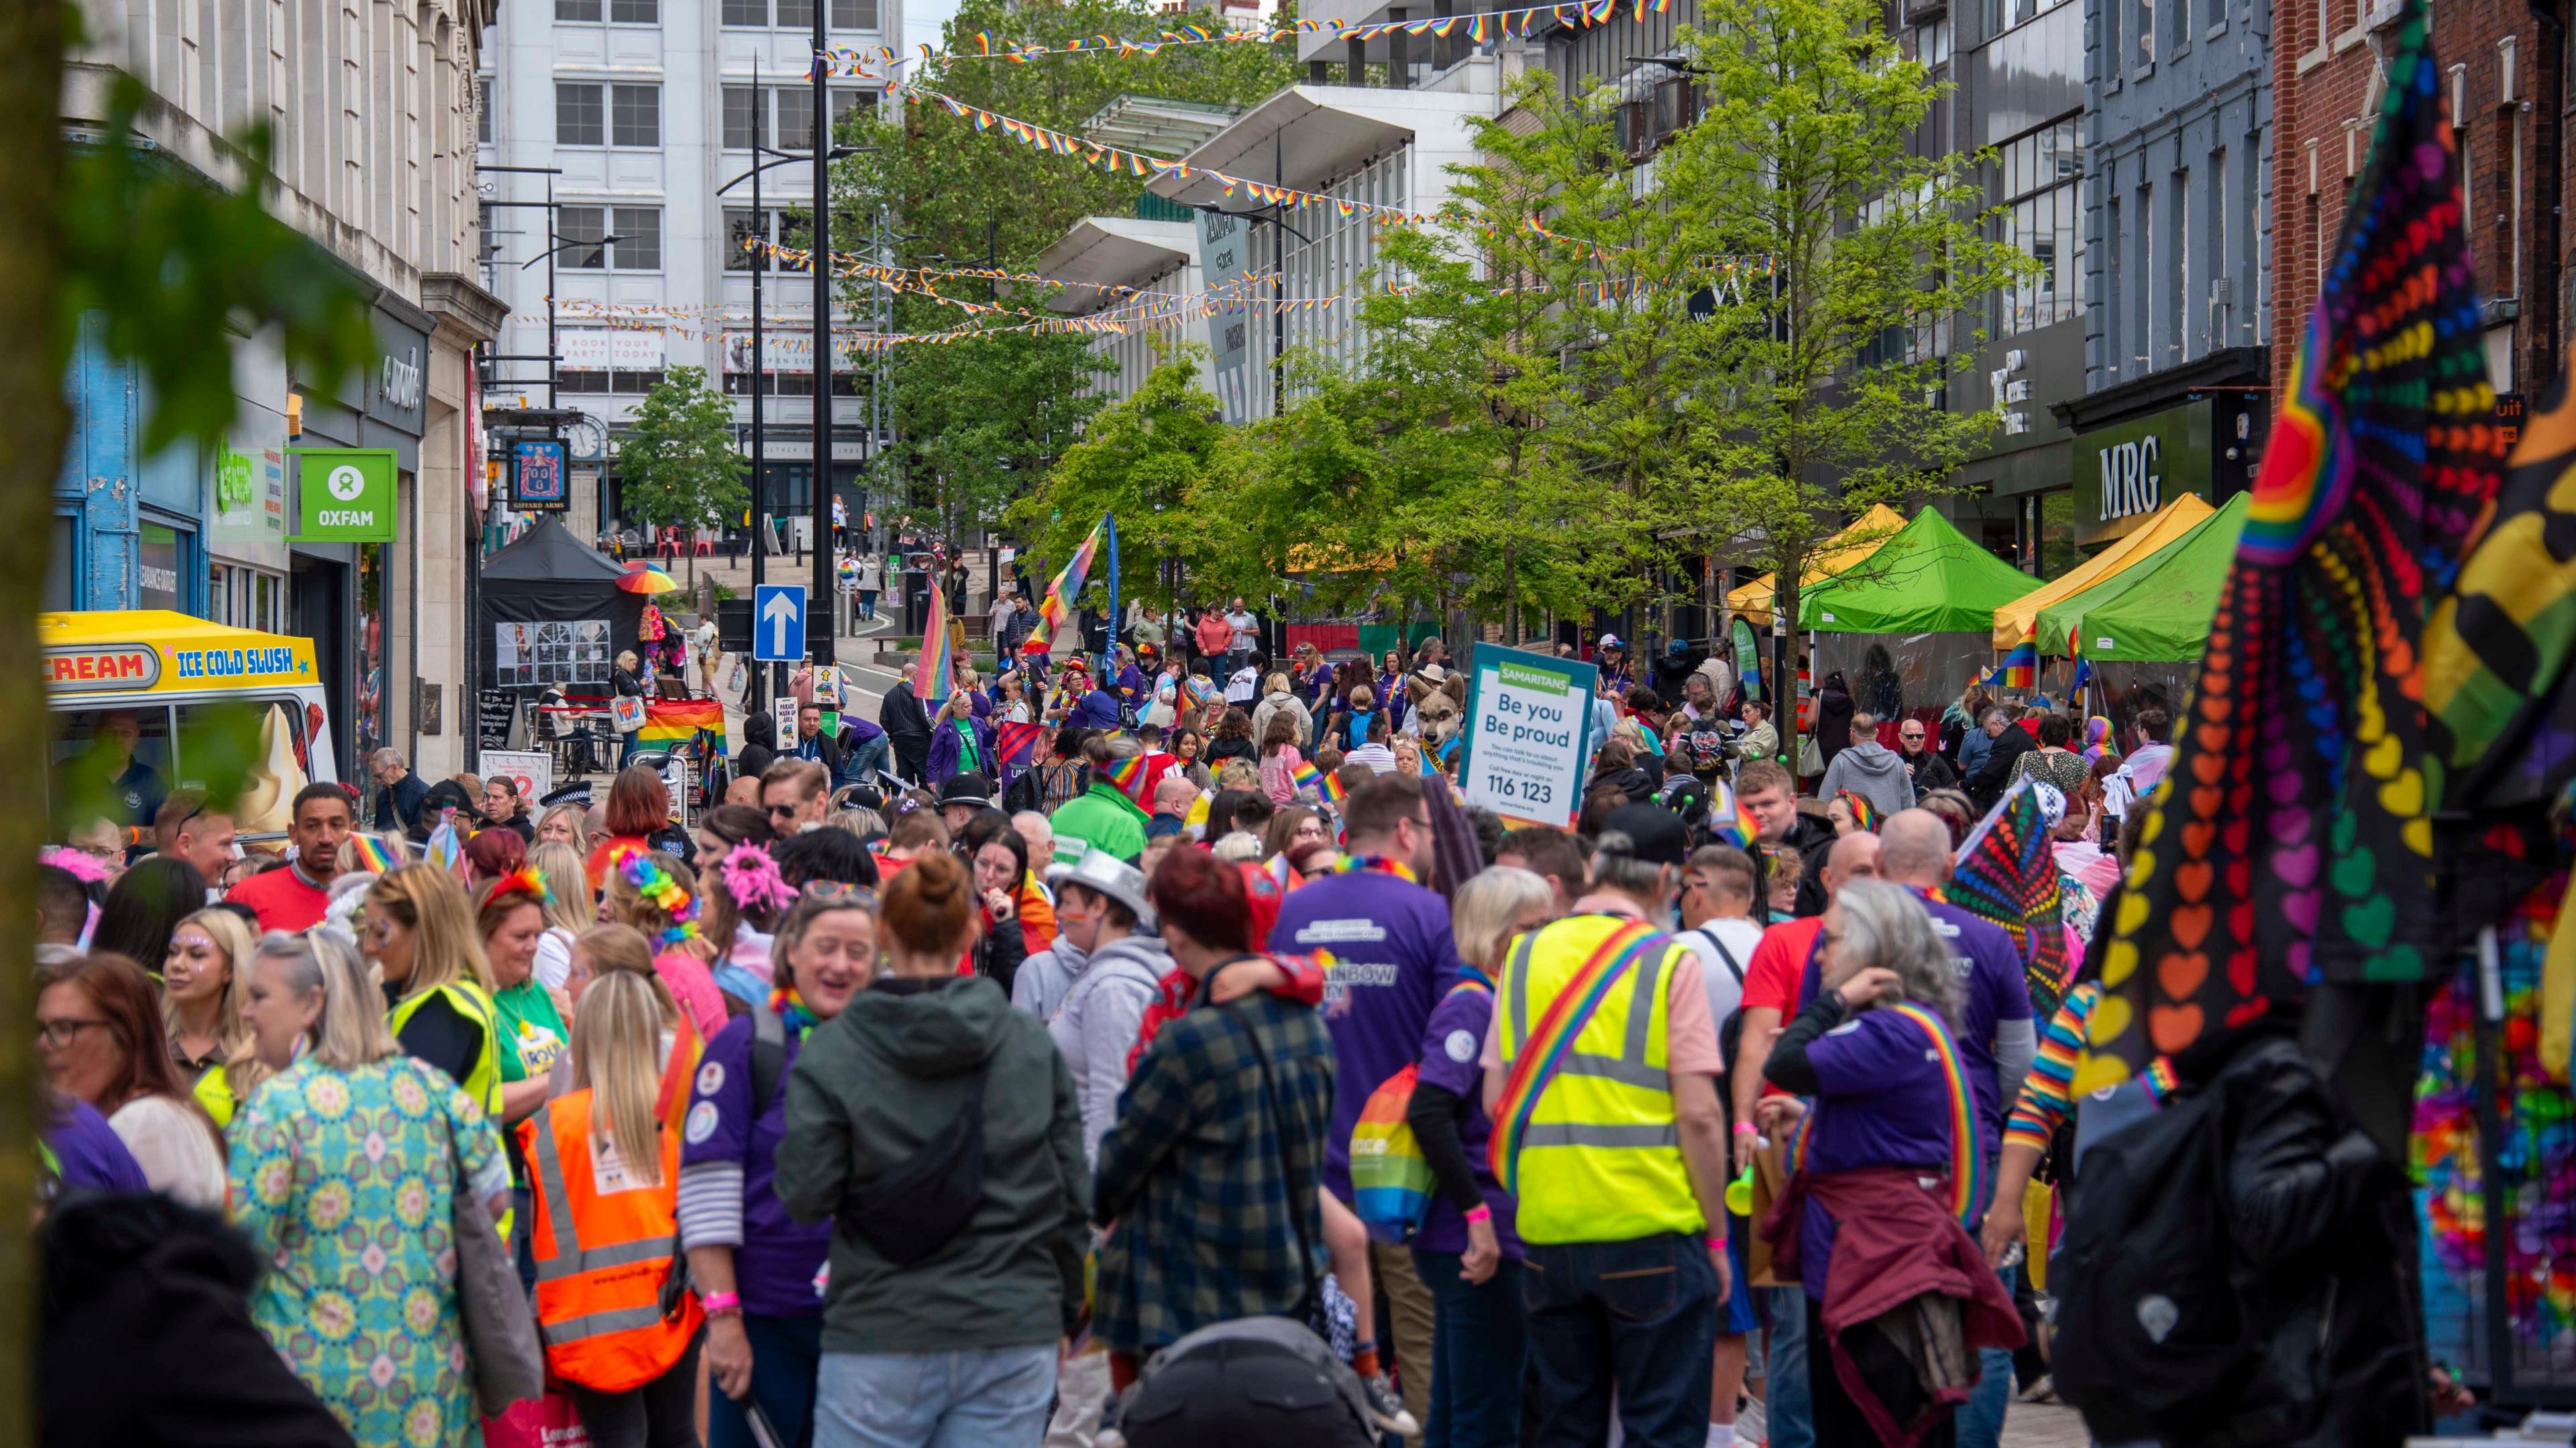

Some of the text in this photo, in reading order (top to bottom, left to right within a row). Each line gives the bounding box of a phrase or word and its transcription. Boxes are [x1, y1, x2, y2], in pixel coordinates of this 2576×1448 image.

[1203, 213, 1236, 245] MANDER
[1216, 249, 1234, 271] CENTRE
[565, 350, 656, 358] PARTY TODAY
[571, 339, 650, 347] BOOK YOUR
[2495, 398, 2522, 416] uit
[2100, 435, 2159, 521] MRG
[319, 510, 374, 526] OXFAM
[140, 564, 176, 592] LEARANCE OUTLET
[176, 646, 294, 679] ICE COLD SLUSH
[1501, 668, 1567, 691] SAMARITANS
[617, 706, 640, 722] YOU
[1498, 693, 1562, 722] Be you
[1485, 714, 1570, 748] Be proud
[1425, 747, 1445, 773] AMBAS
[1482, 750, 1508, 761] anything
[1509, 754, 1525, 763] that's
[1526, 759, 1552, 770] troubling
[1491, 742, 1502, 750] You
[1514, 748, 1525, 756] talk
[1540, 754, 1558, 763] about
[1487, 774, 1552, 803] 116 123
[1530, 774, 1545, 782] night
[1499, 800, 1534, 813] samaritans.org
